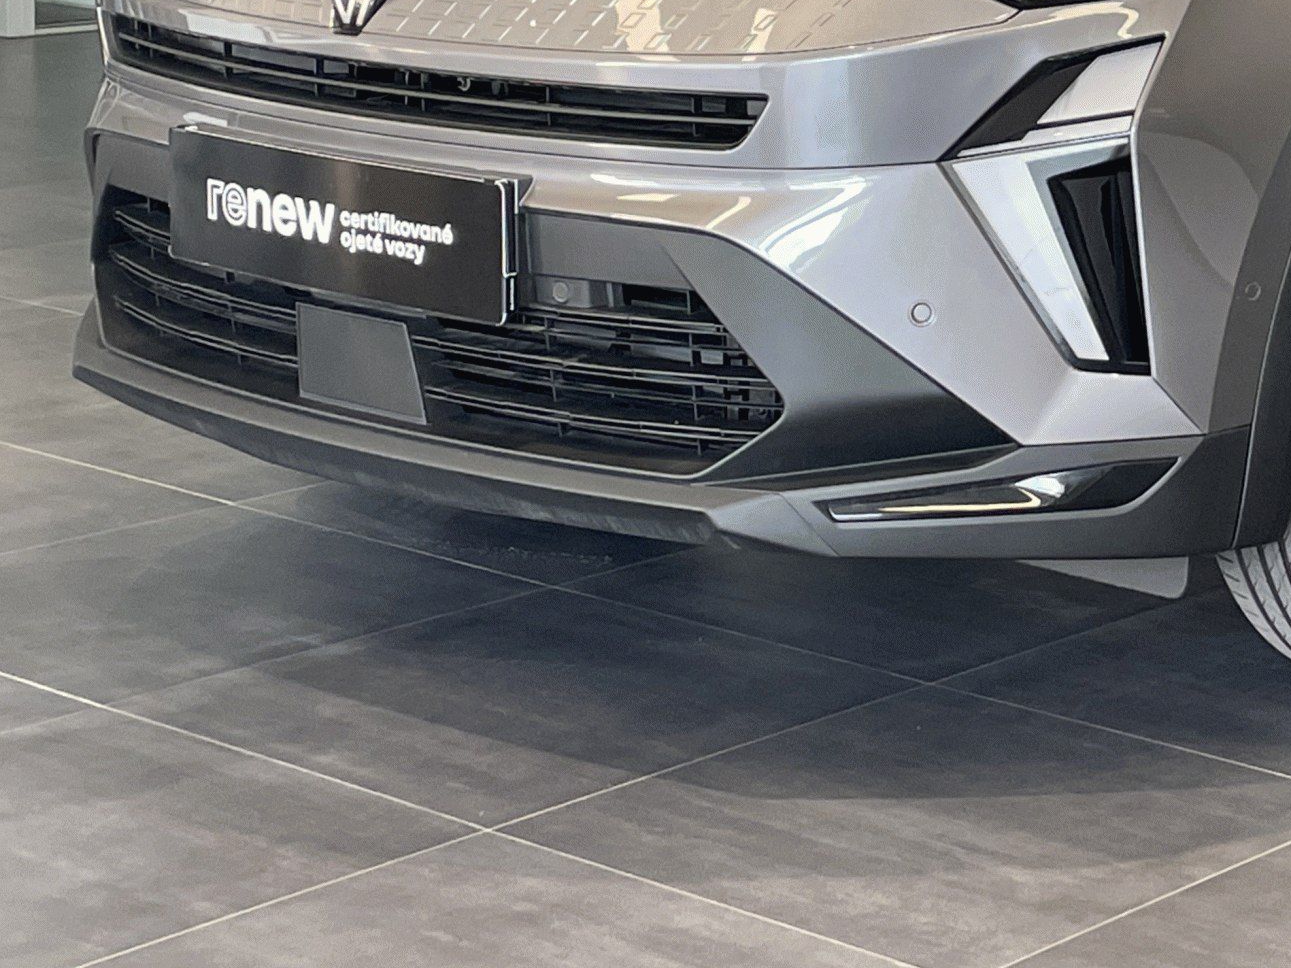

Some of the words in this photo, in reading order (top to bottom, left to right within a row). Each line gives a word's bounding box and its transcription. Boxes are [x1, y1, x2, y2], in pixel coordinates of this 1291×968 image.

[207, 178, 335, 244] renew
[339, 209, 455, 245] certifikované
[339, 230, 383, 254] ojeté
[384, 239, 426, 266] vozy
